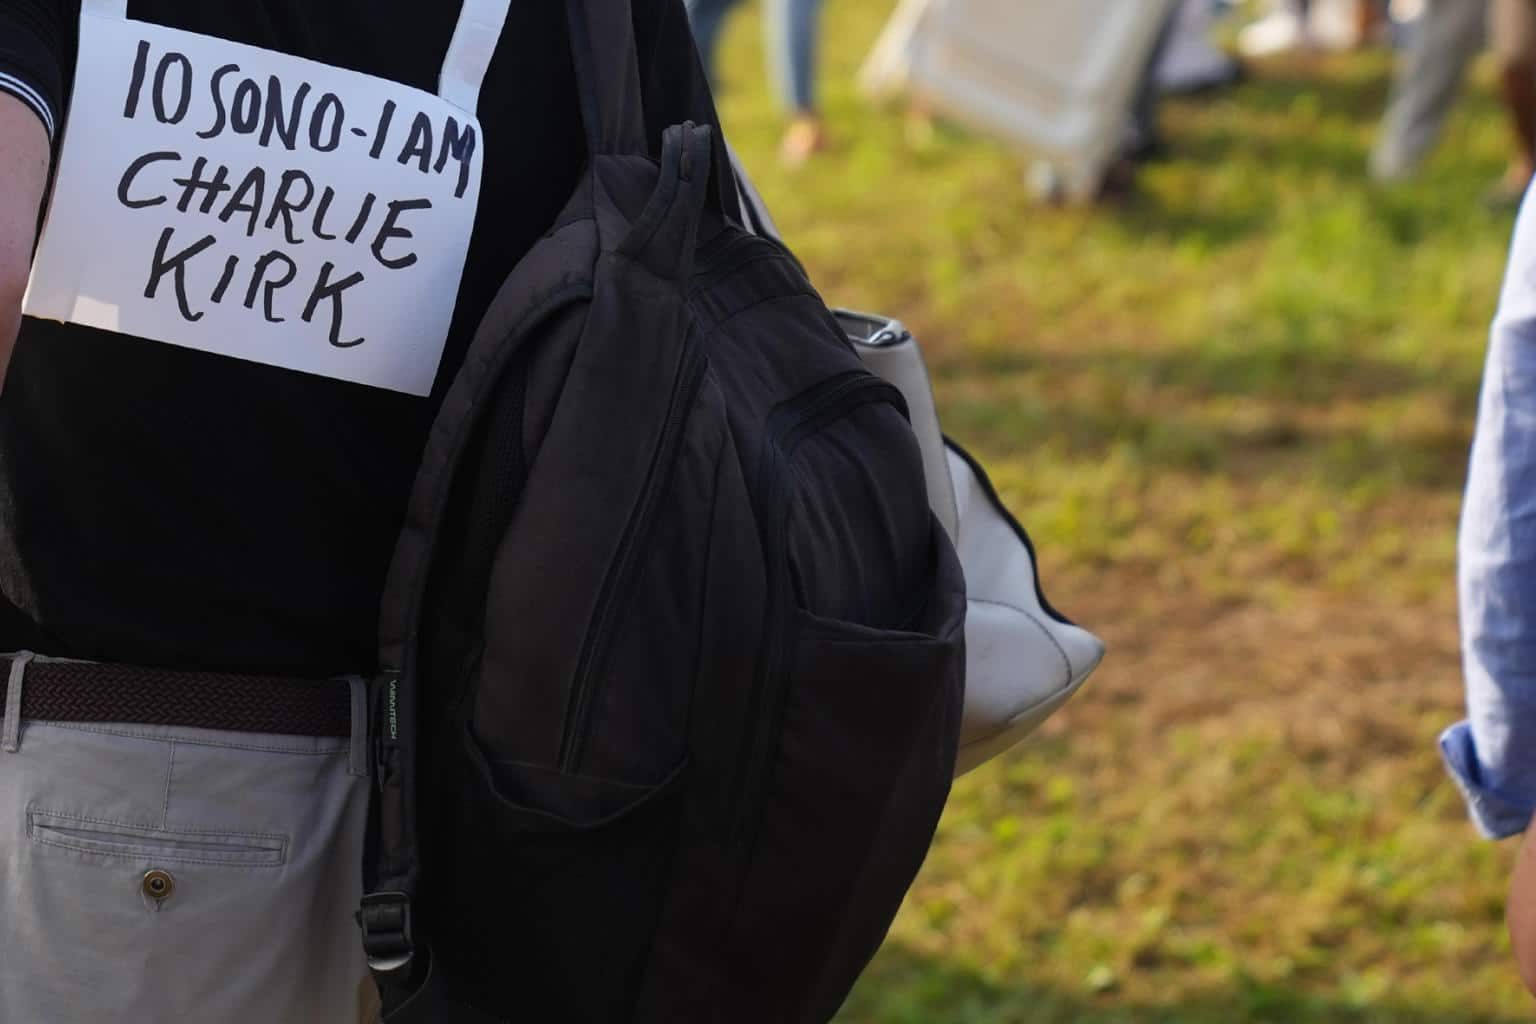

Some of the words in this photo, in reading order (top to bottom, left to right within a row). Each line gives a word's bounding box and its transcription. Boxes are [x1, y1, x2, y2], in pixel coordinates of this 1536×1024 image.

[123, 39, 193, 125] IO
[397, 111, 476, 199] AM
[117, 151, 432, 269] CHARLIE
[144, 227, 365, 348] KIRK
